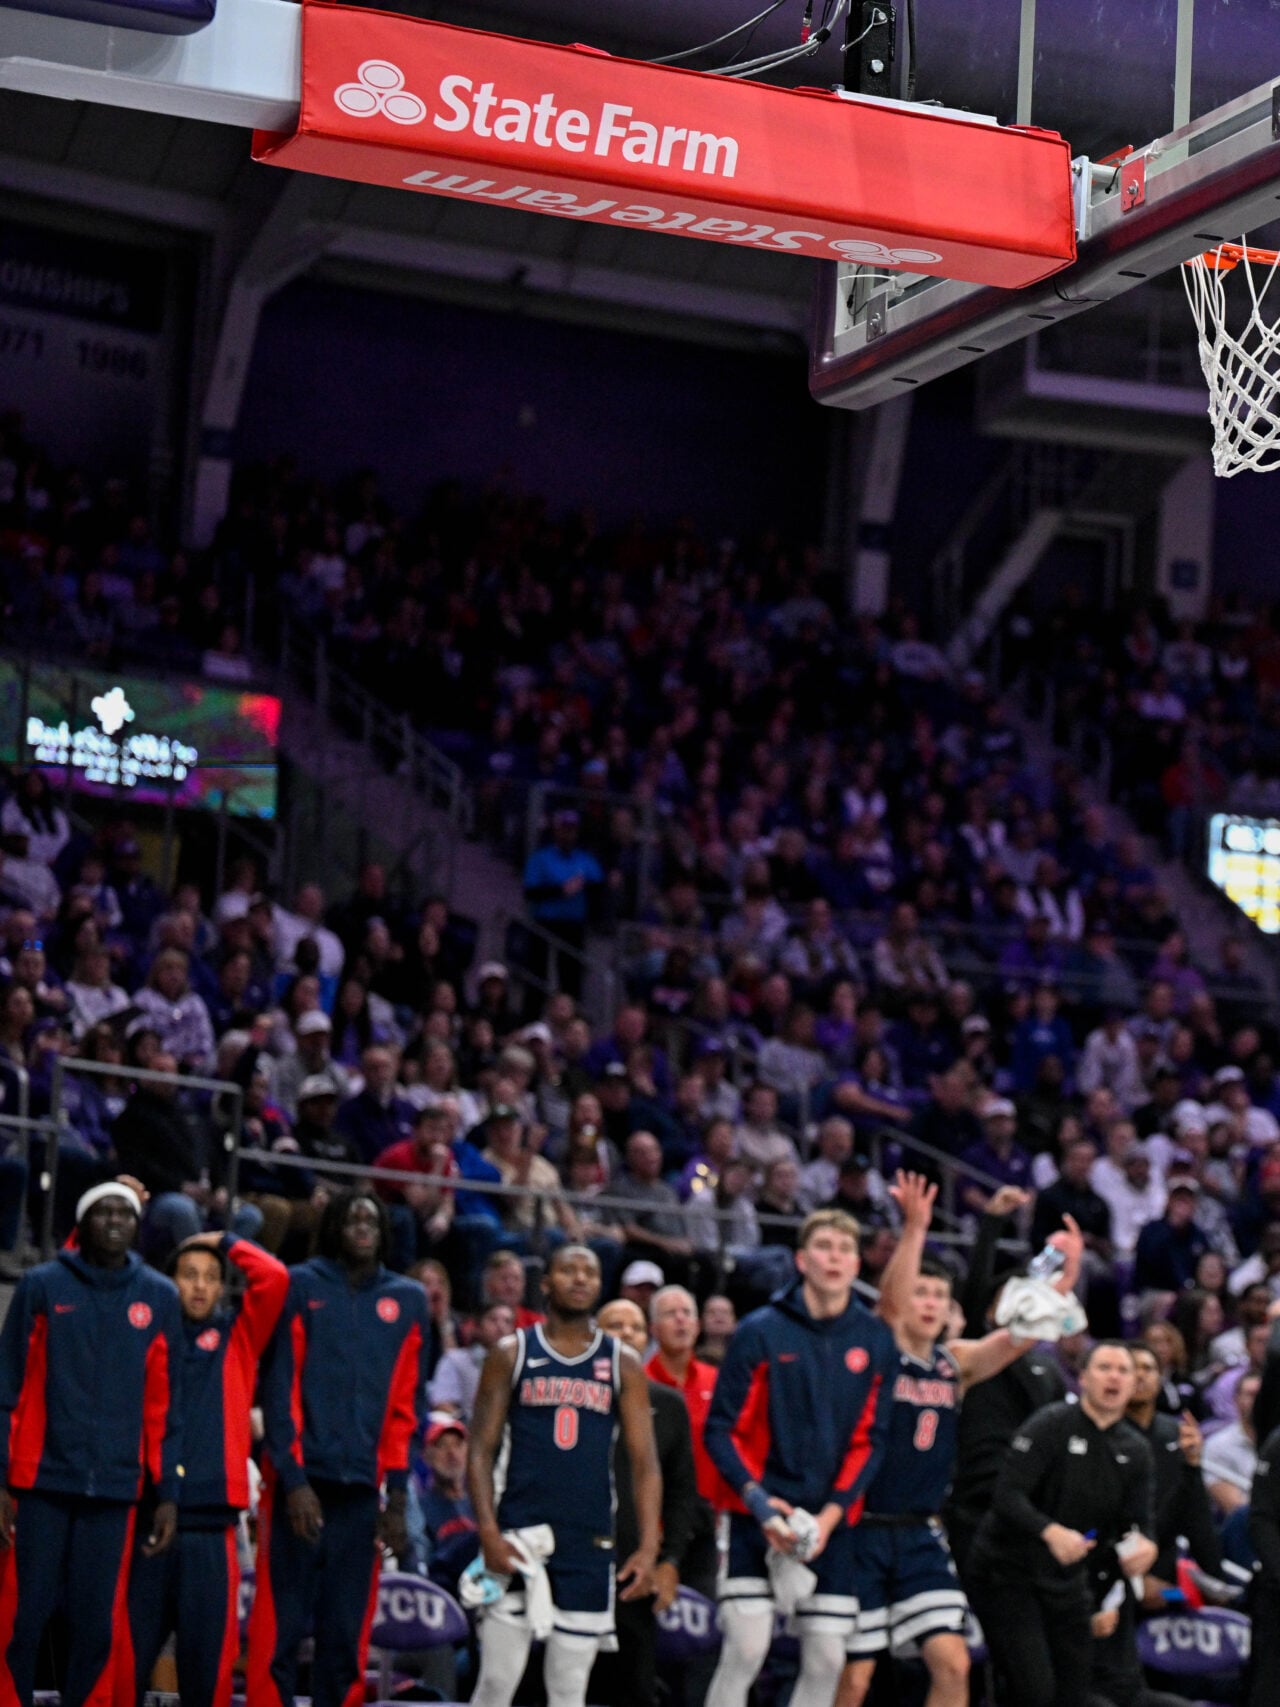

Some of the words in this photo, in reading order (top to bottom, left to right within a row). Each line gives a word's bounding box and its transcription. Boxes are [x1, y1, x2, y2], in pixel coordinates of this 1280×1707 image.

[520, 1376, 612, 1415] ARIZONA
[554, 1404, 579, 1451] 0
[1147, 1616, 1221, 1656] TCU
